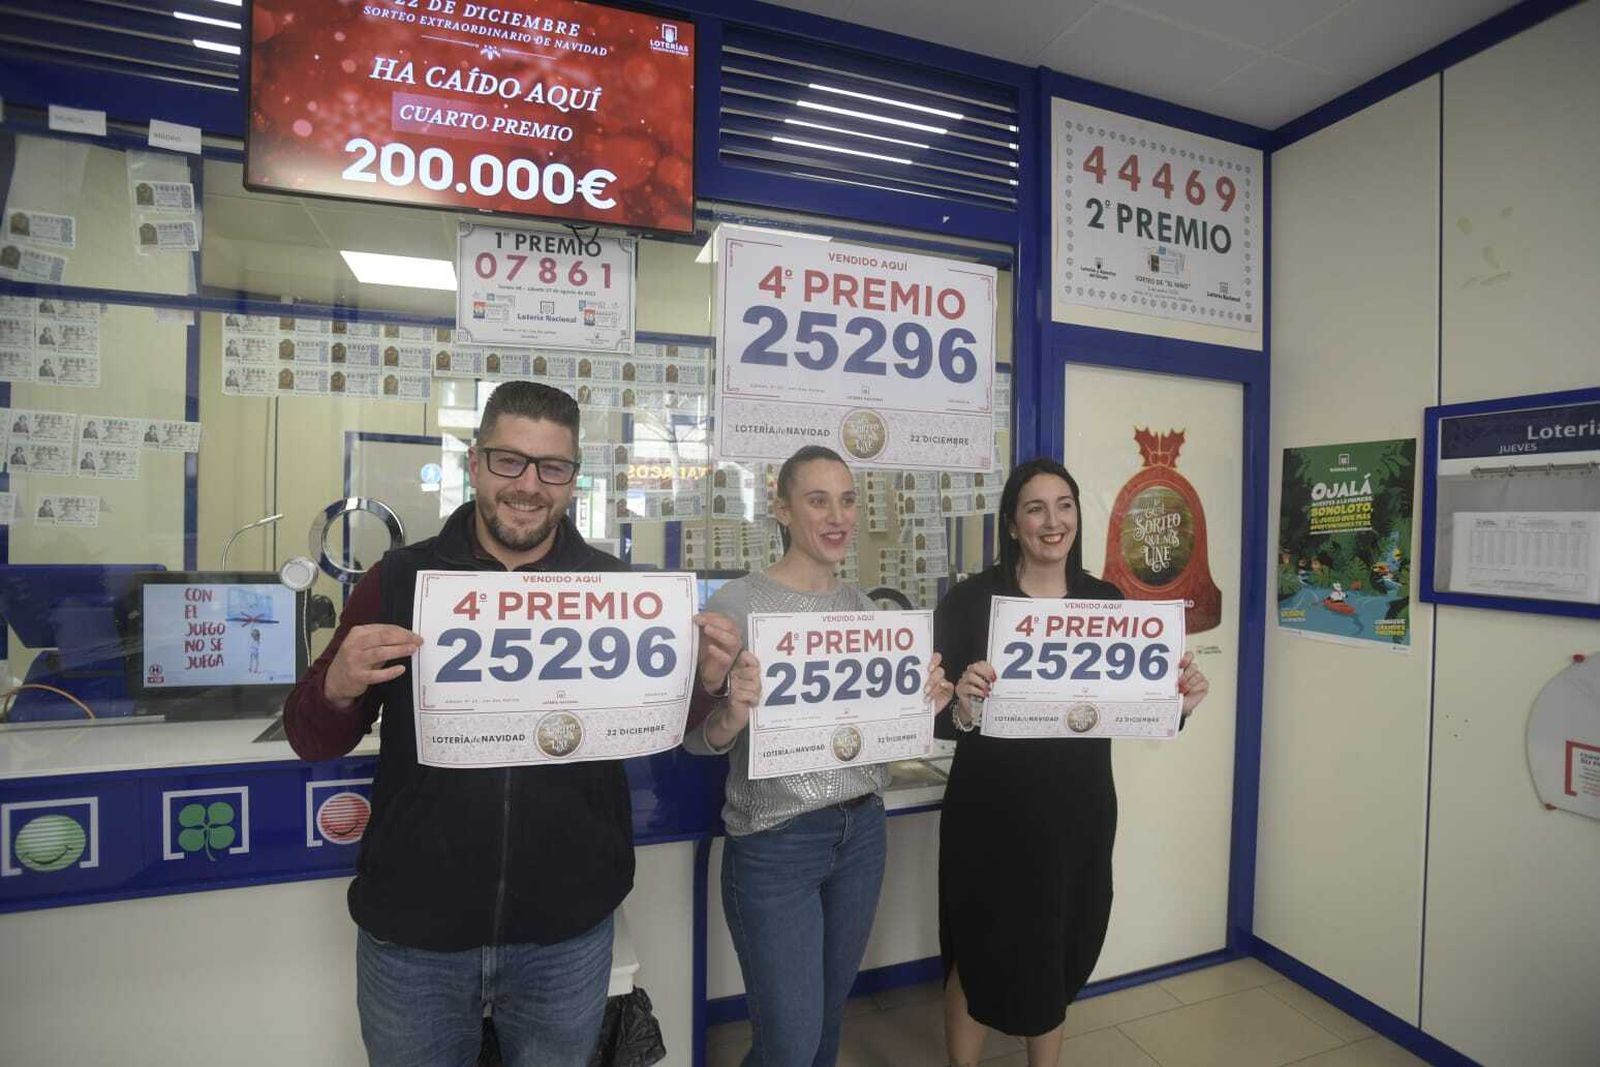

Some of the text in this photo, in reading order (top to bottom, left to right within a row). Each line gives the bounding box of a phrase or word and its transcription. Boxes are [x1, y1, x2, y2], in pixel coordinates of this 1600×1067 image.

[427, 0, 456, 14] DE
[463, 3, 580, 37] DICIEMBRE
[363, 6, 608, 57] SORTEO EXTRAORDINARIO DE NAVIDAD
[370, 57, 602, 113] HA CAÍDO AQUÍ
[399, 104, 574, 143] CUARTO PREMIO
[342, 137, 618, 210] 200.000€
[1082, 146, 1237, 212] 44469
[1116, 203, 1232, 254] PREMIO
[515, 233, 602, 257] PREMIO
[475, 252, 611, 288] 07861
[828, 252, 908, 272] VENDIDO AQUÍ
[804, 269, 966, 320] PREMIO
[546, 314, 577, 324] Nacional
[740, 304, 977, 384] 25296
[735, 424, 775, 435] LOTERÍA
[786, 427, 831, 438] NAVIDAD
[910, 434, 969, 446] 22 DICIEMBRE
[1499, 442, 1537, 454] JUEVES
[1311, 473, 1372, 500] OJALÁ
[1133, 513, 1181, 541] SORTEO
[1141, 545, 1171, 572] UNE
[522, 575, 573, 583] VENDIDO
[184, 588, 213, 602] CON
[498, 591, 664, 621] PREMIO
[1064, 602, 1101, 610] VENDIDO
[184, 605, 198, 620] EL
[822, 614, 855, 623] VENDIDO
[184, 621, 226, 637] JUEGO
[1046, 616, 1164, 639] PREMIO
[184, 637, 224, 653] NO SE
[806, 627, 914, 655] PREMIO
[184, 654, 225, 671] JUEGA
[435, 626, 678, 683] 25296
[1001, 642, 1170, 681] 25296
[764, 655, 921, 707] 25296
[432, 735, 470, 744] LOTERÍA
[481, 734, 526, 743] NAVIDAD
[607, 724, 666, 737] 22 DICIEMBRE
[795, 744, 826, 754] NAVIDAD
